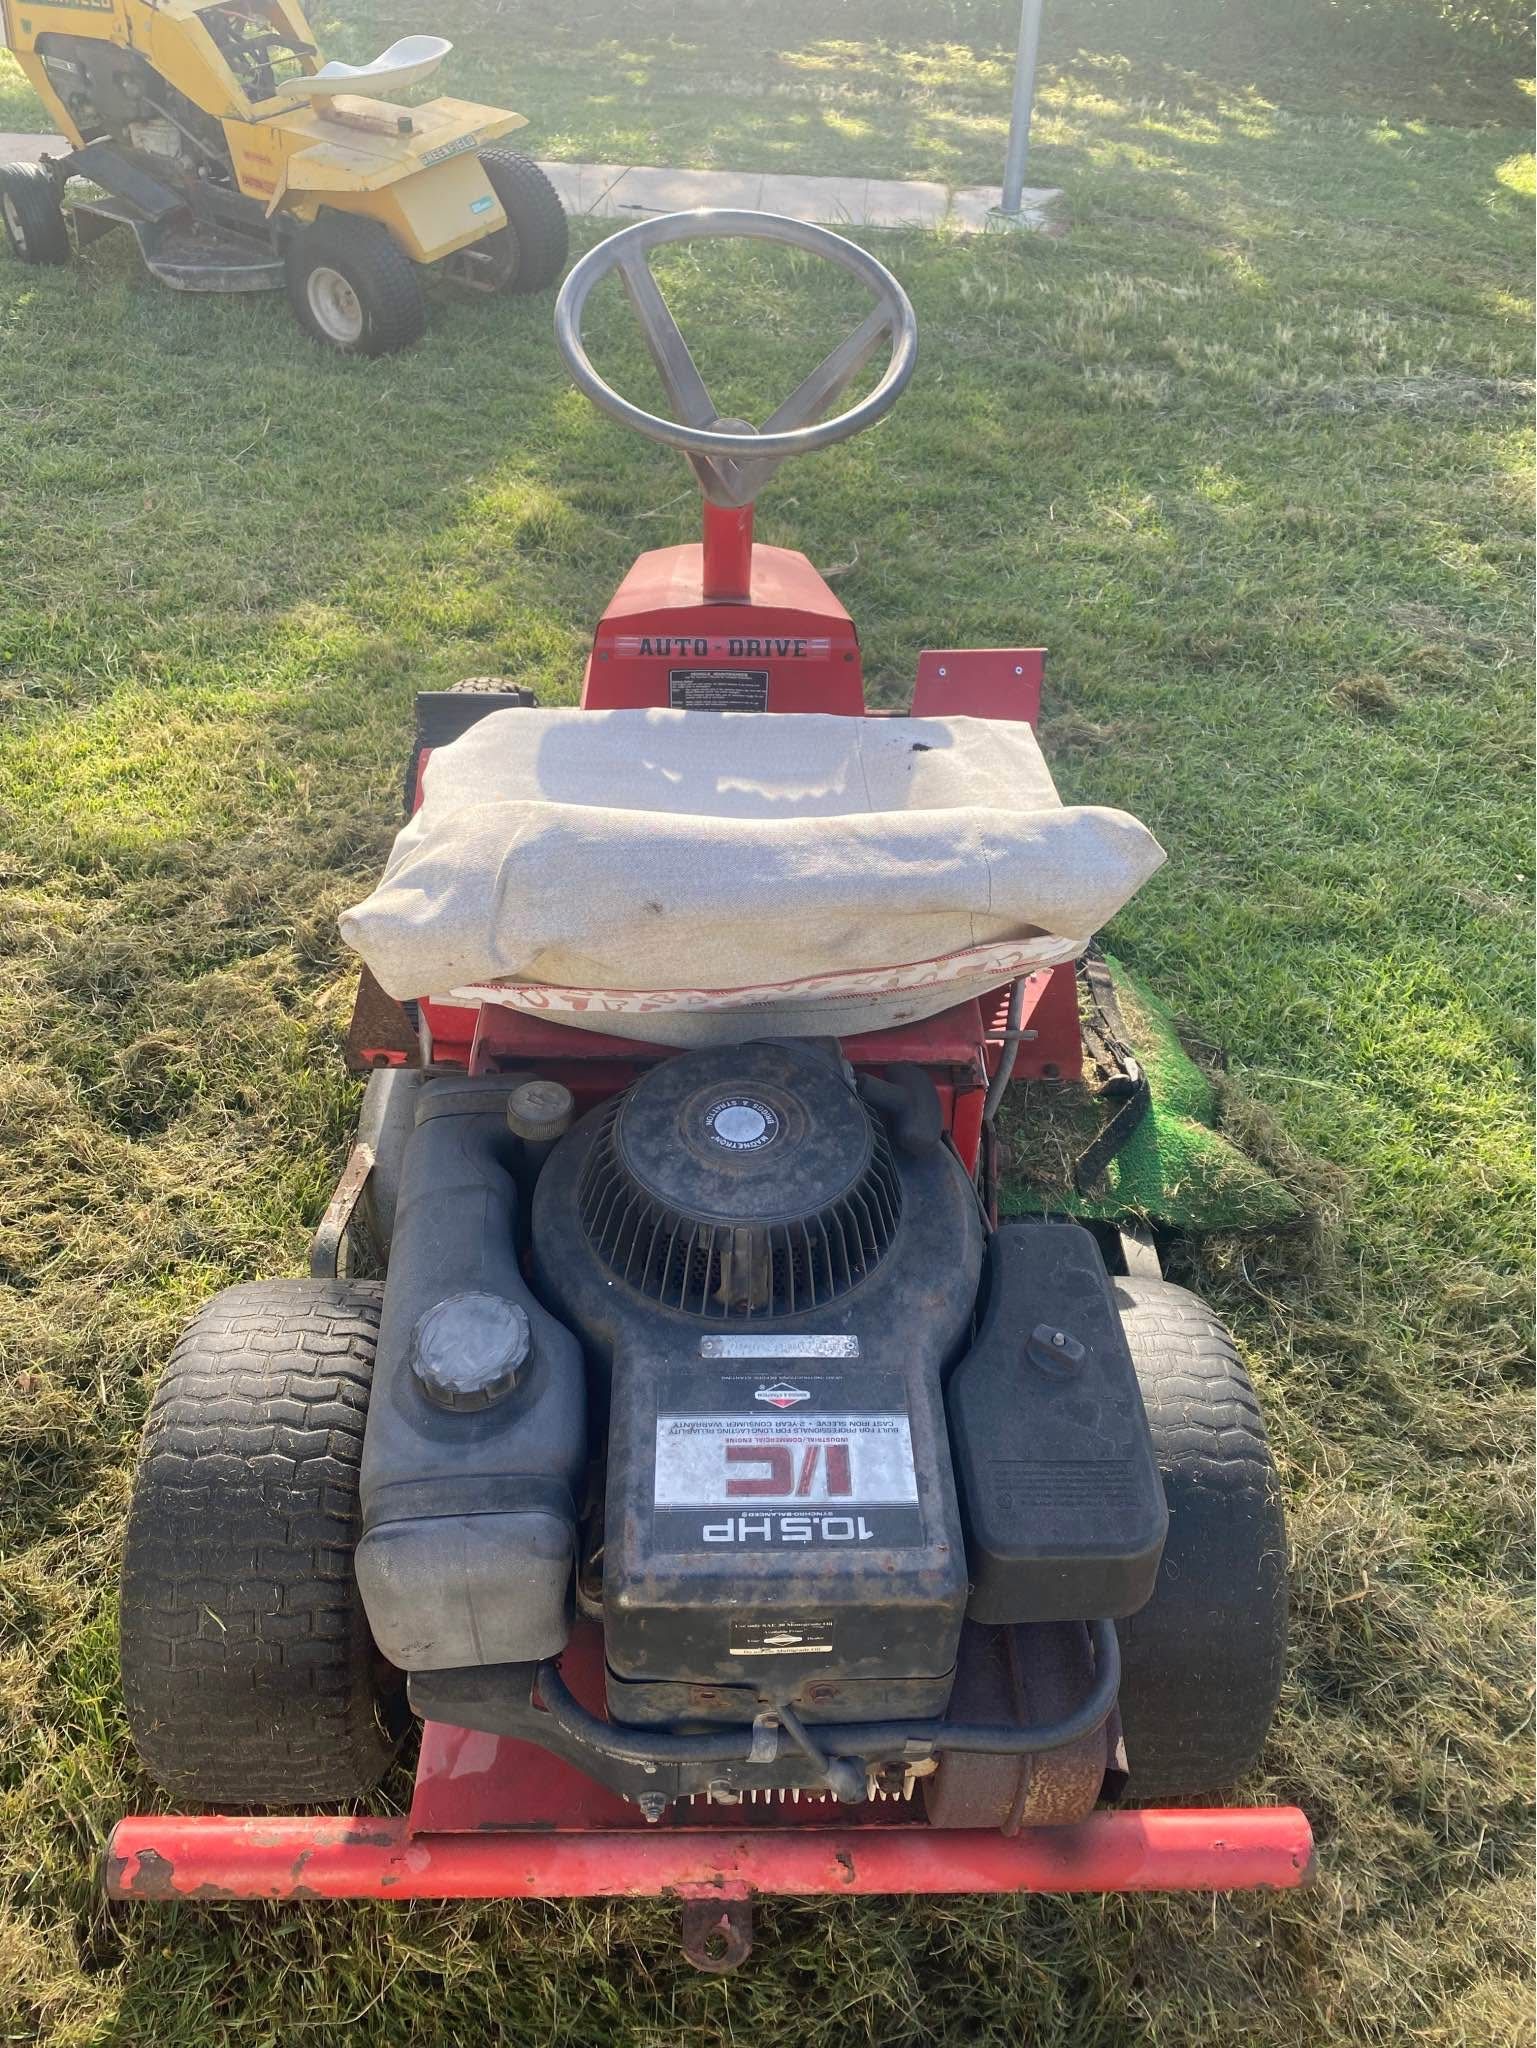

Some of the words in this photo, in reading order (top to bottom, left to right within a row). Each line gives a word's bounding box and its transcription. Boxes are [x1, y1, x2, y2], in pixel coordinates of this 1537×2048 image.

[639, 637, 708, 657] AUTO
[728, 638, 808, 657] DRIVE
[705, 1100, 737, 1126] STRATTON
[753, 1103, 775, 1125] BRIGGS
[669, 1427, 715, 1435] RELIABILITY
[726, 1444, 852, 1497] I/C
[702, 1517, 771, 1542] HP
[781, 1516, 874, 1541] 10.5
